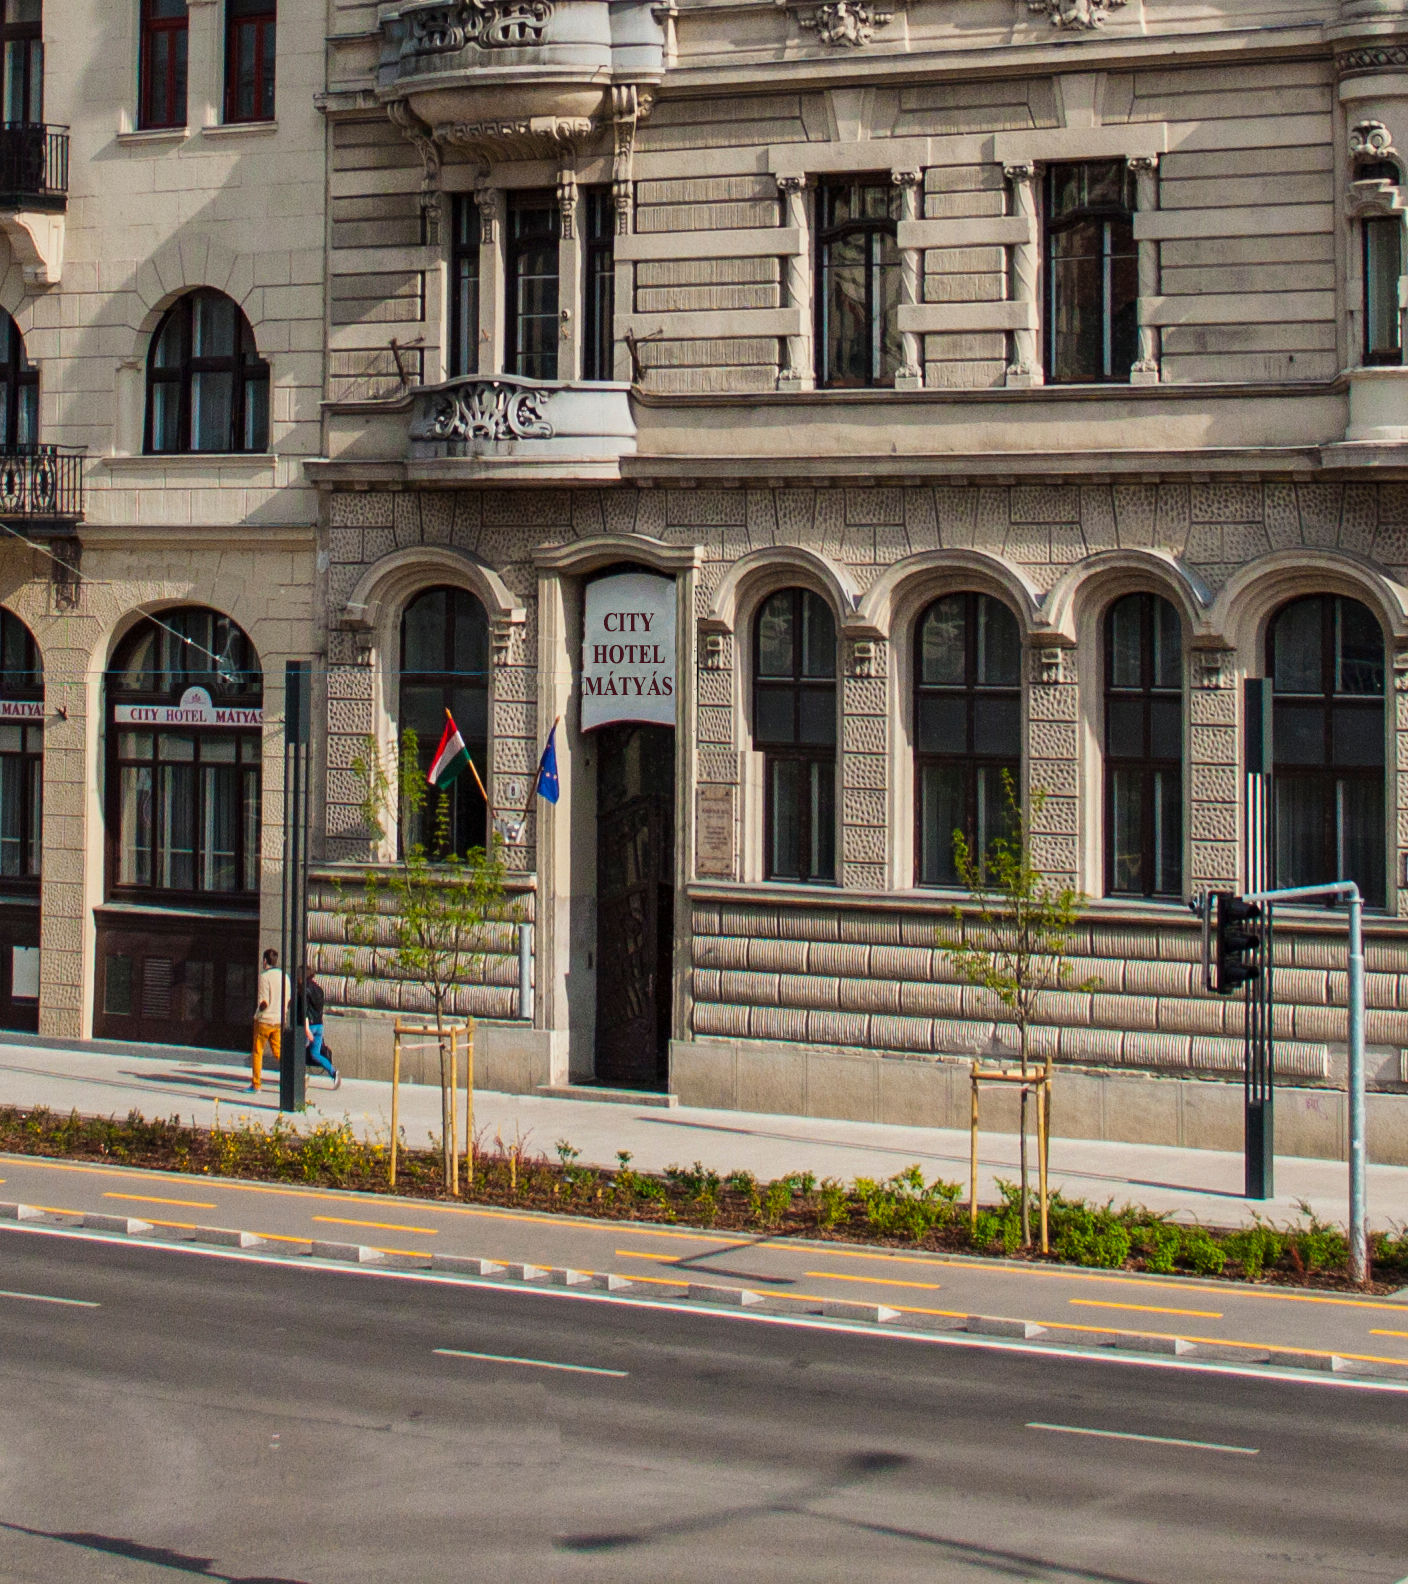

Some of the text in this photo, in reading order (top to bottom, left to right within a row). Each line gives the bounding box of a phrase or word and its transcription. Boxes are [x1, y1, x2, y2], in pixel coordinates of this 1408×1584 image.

[603, 612, 655, 632] CITY
[592, 644, 666, 664] HOTEL
[584, 670, 674, 696] MÁTYÁS
[130, 708, 159, 721] CITY
[166, 709, 207, 723] HOTEL
